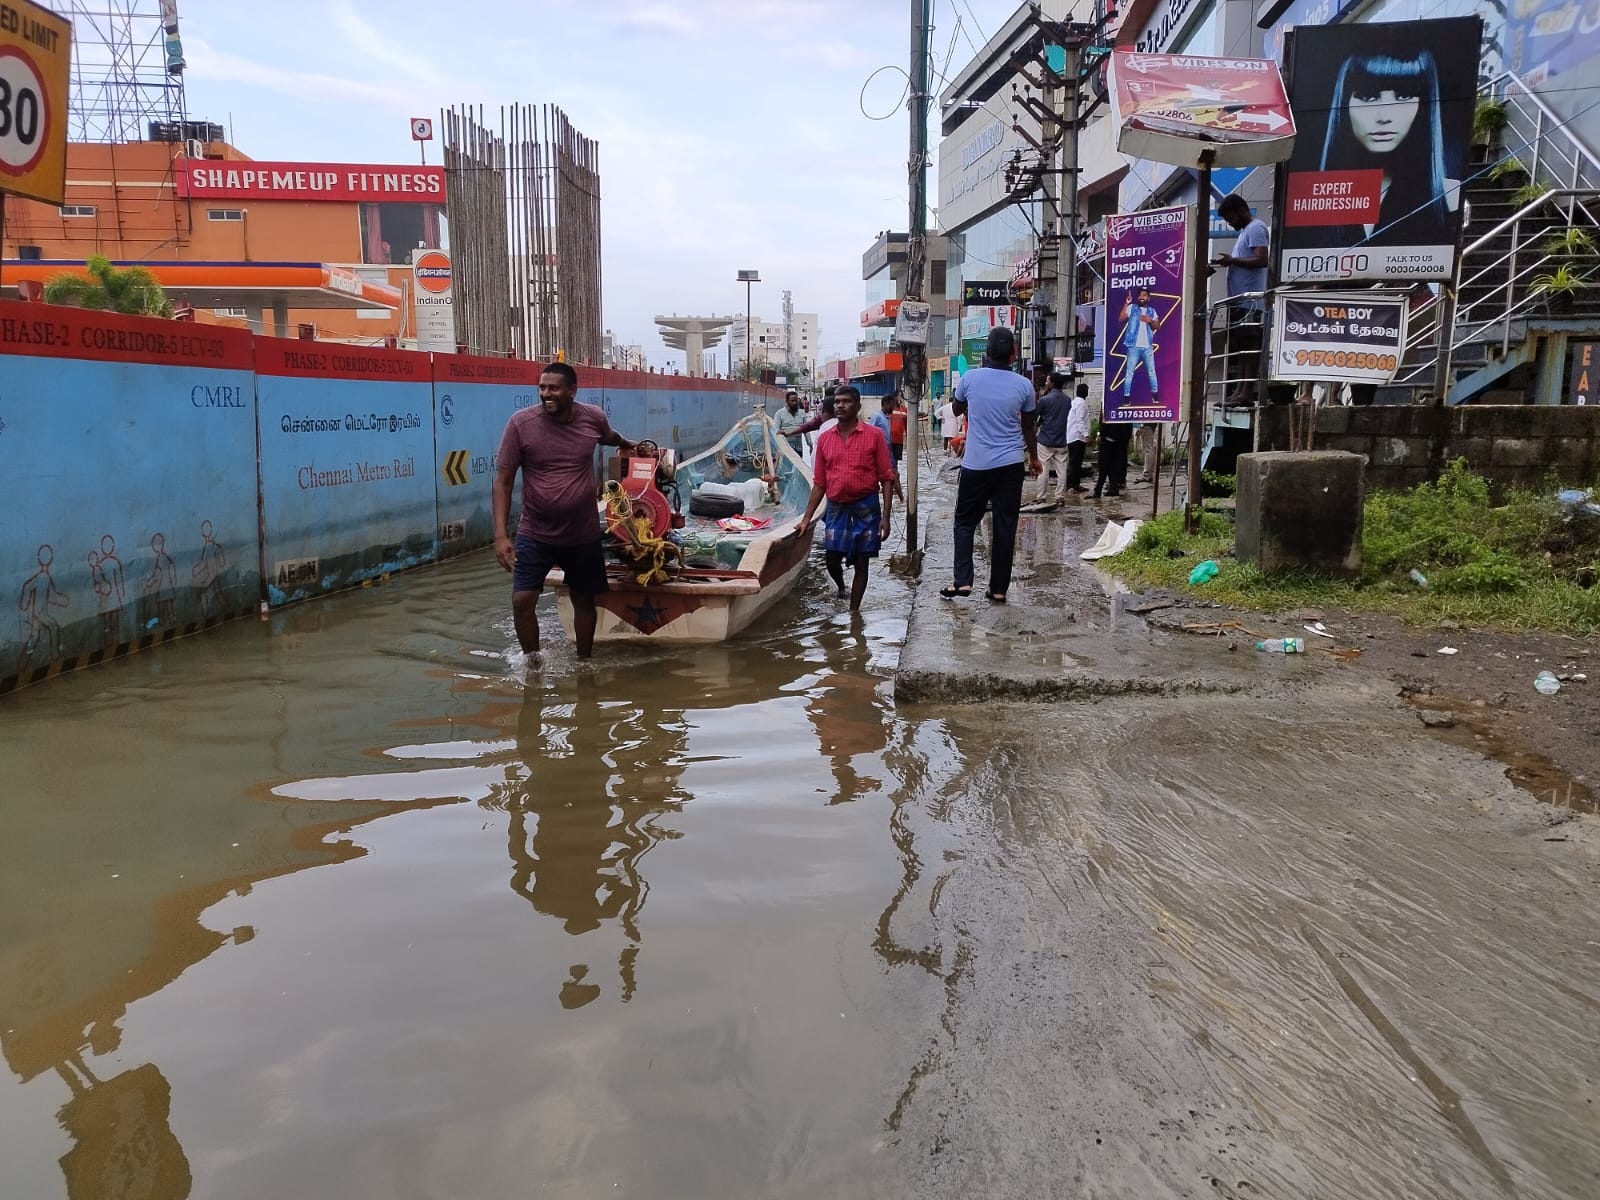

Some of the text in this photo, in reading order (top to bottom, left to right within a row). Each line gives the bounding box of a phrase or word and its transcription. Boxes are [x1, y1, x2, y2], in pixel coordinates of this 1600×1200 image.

[23, 15, 58, 54] LIMIT
[1176, 57, 1264, 69] VIBES ON
[193, 169, 440, 193] SHAPEMEUP FITNESS
[1313, 182, 1353, 195] EXPERT
[1294, 197, 1370, 211] HAIRDRESSING
[1136, 212, 1183, 225] VIBES ON
[1111, 246, 1146, 258] Learn
[1111, 260, 1153, 274] Inspire
[1385, 265, 1445, 274] 9003040008
[1111, 276, 1156, 290] Explore
[0, 318, 70, 346] HASE-2
[81, 326, 178, 355] CORRIDOR-5
[1286, 322, 1399, 338] ஆட்கள் தேவை
[284, 351, 327, 370] PHASE-2
[1296, 349, 1397, 371] 9176025068
[191, 385, 246, 408] CMRL
[1118, 410, 1173, 418] 9176202806
[281, 414, 342, 433] சென்னை
[471, 456, 488, 474] MEN
[298, 457, 415, 490] Chennai Metro Rail
